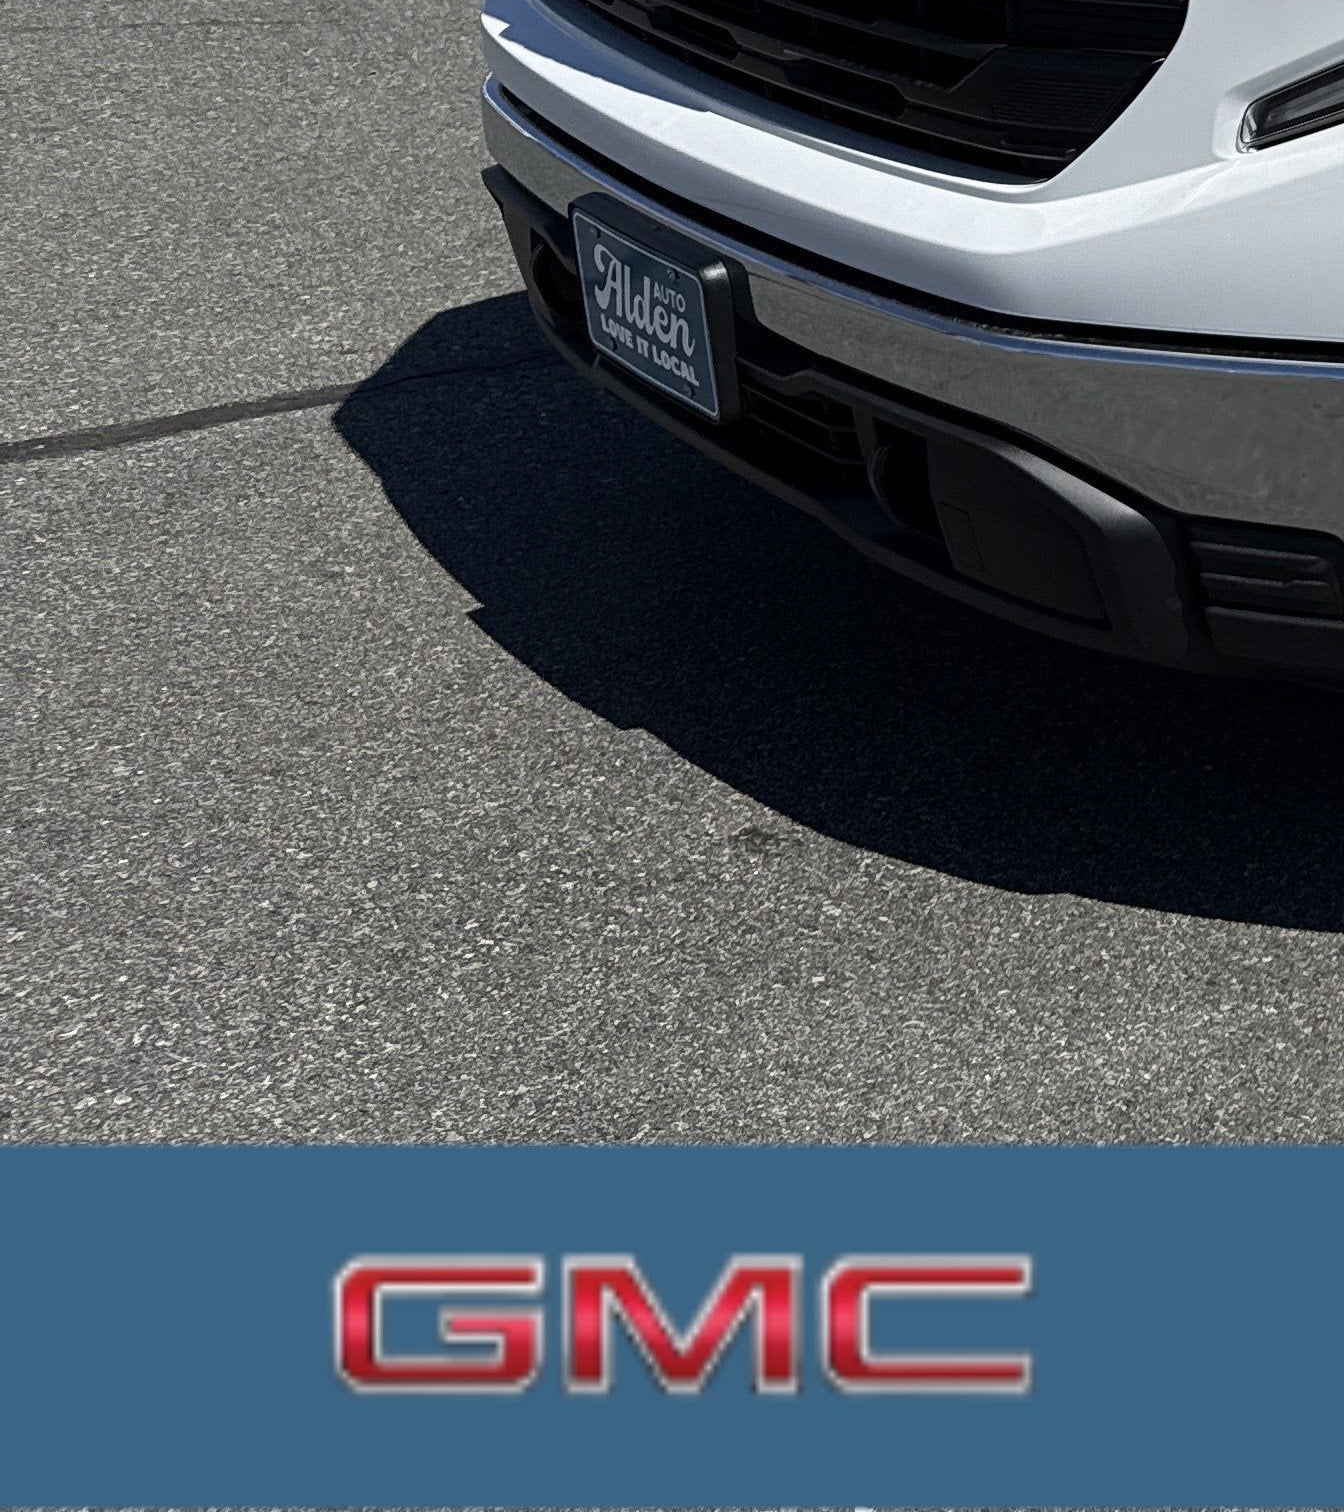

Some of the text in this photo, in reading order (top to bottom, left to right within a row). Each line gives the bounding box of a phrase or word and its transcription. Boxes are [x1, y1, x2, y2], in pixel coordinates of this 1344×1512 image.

[593, 243, 696, 357] Alden
[652, 281, 687, 313] AUTO
[600, 313, 700, 388] LOVE IT LOCAL
